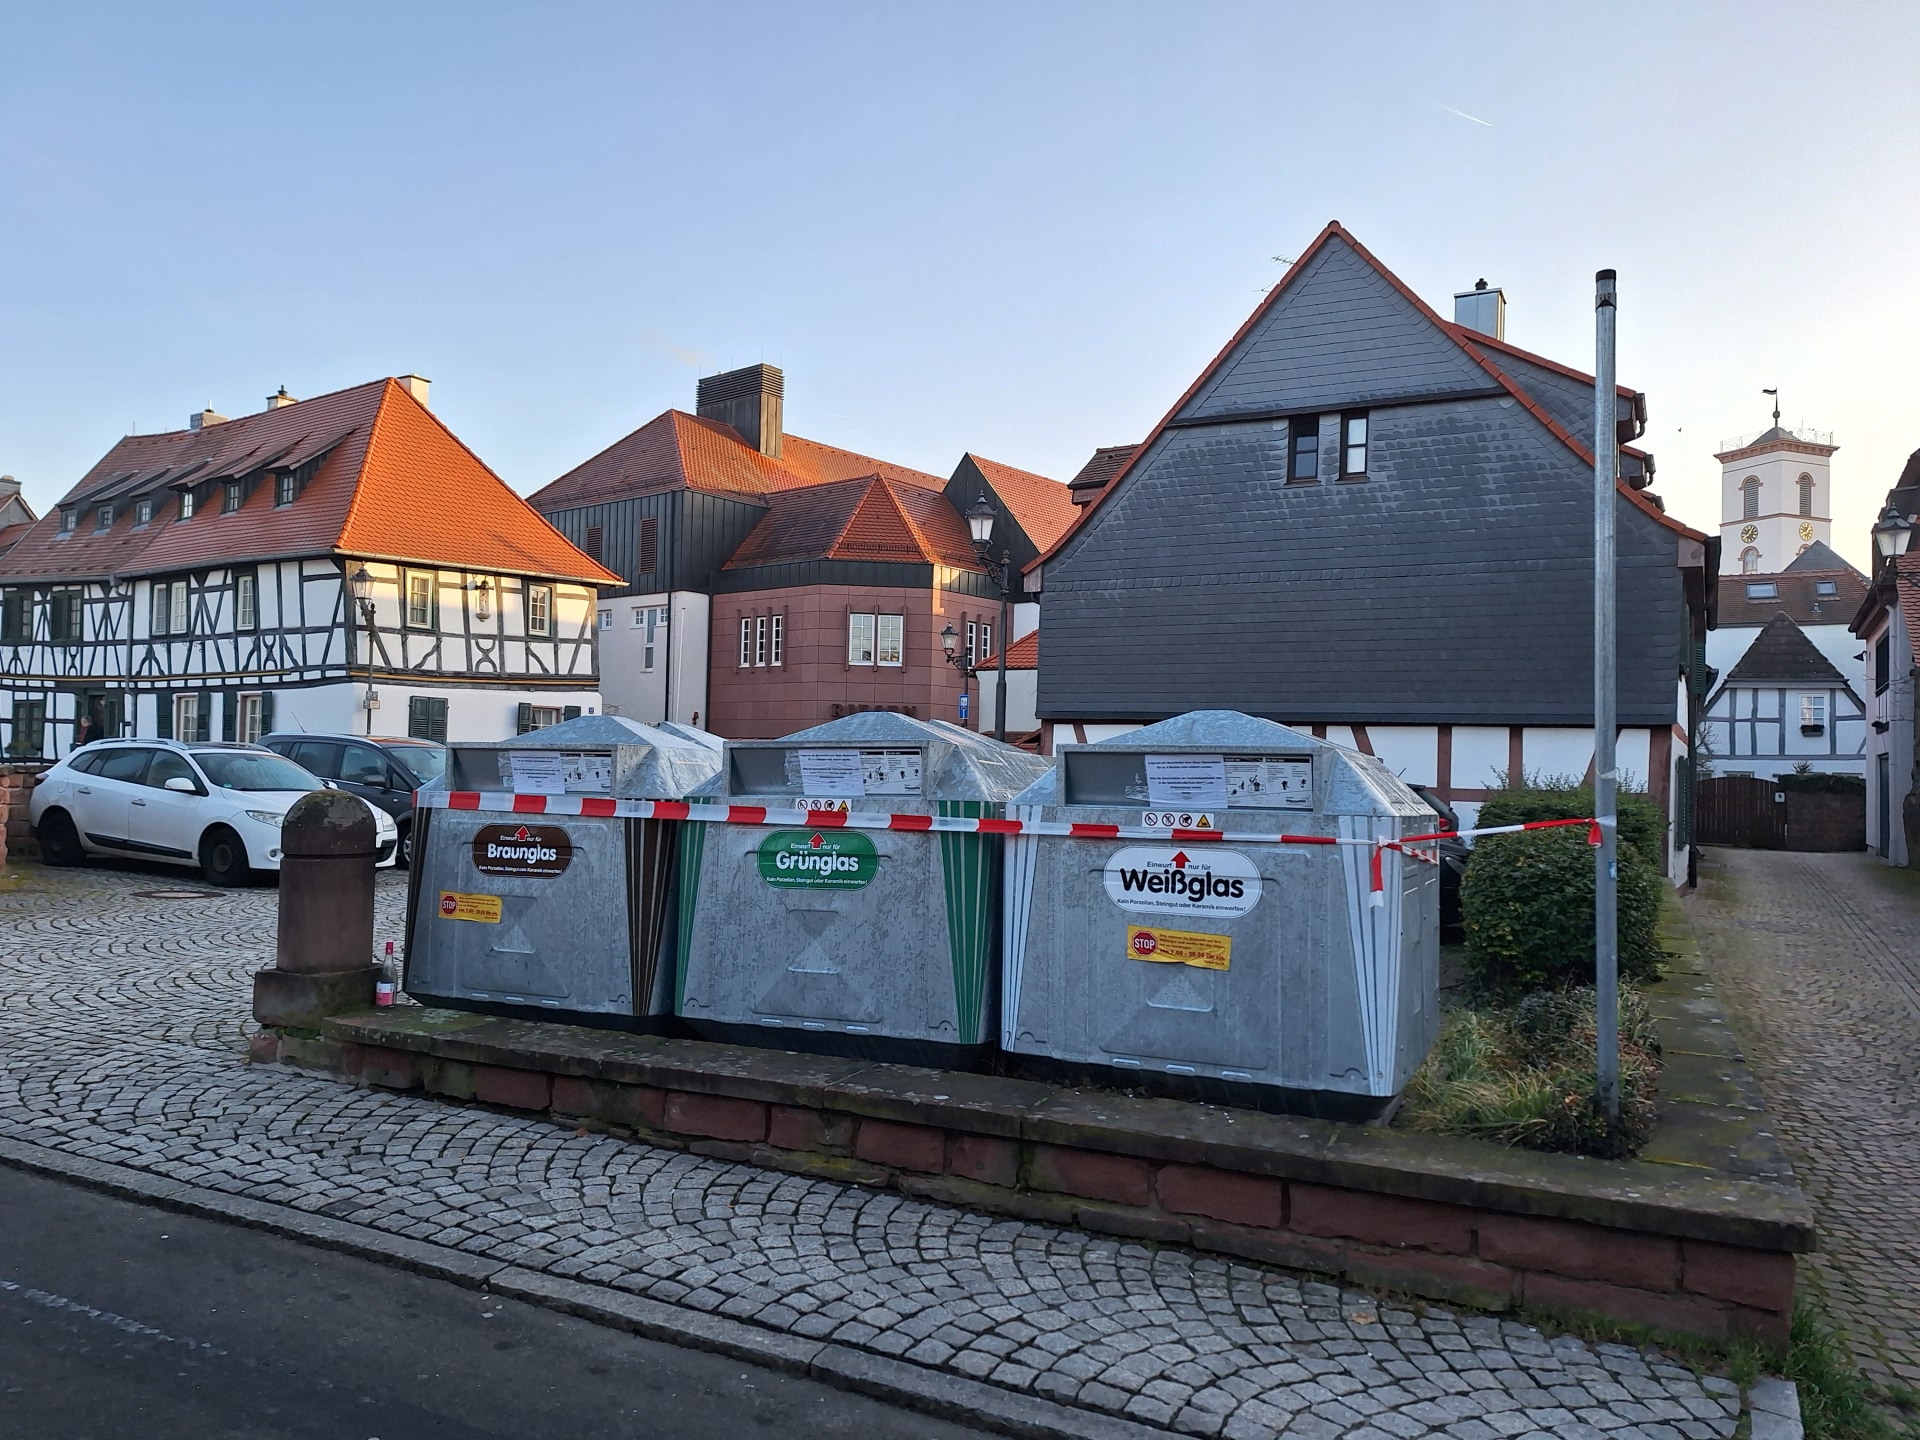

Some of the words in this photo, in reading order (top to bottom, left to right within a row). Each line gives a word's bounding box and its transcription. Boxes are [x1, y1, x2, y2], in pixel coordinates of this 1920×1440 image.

[487, 843, 557, 864] Braunglas
[776, 850, 859, 876] Grünglas
[1120, 868, 1244, 902] Weißglas
[442, 900, 456, 910] STOP
[1134, 938, 1155, 949] STOP
